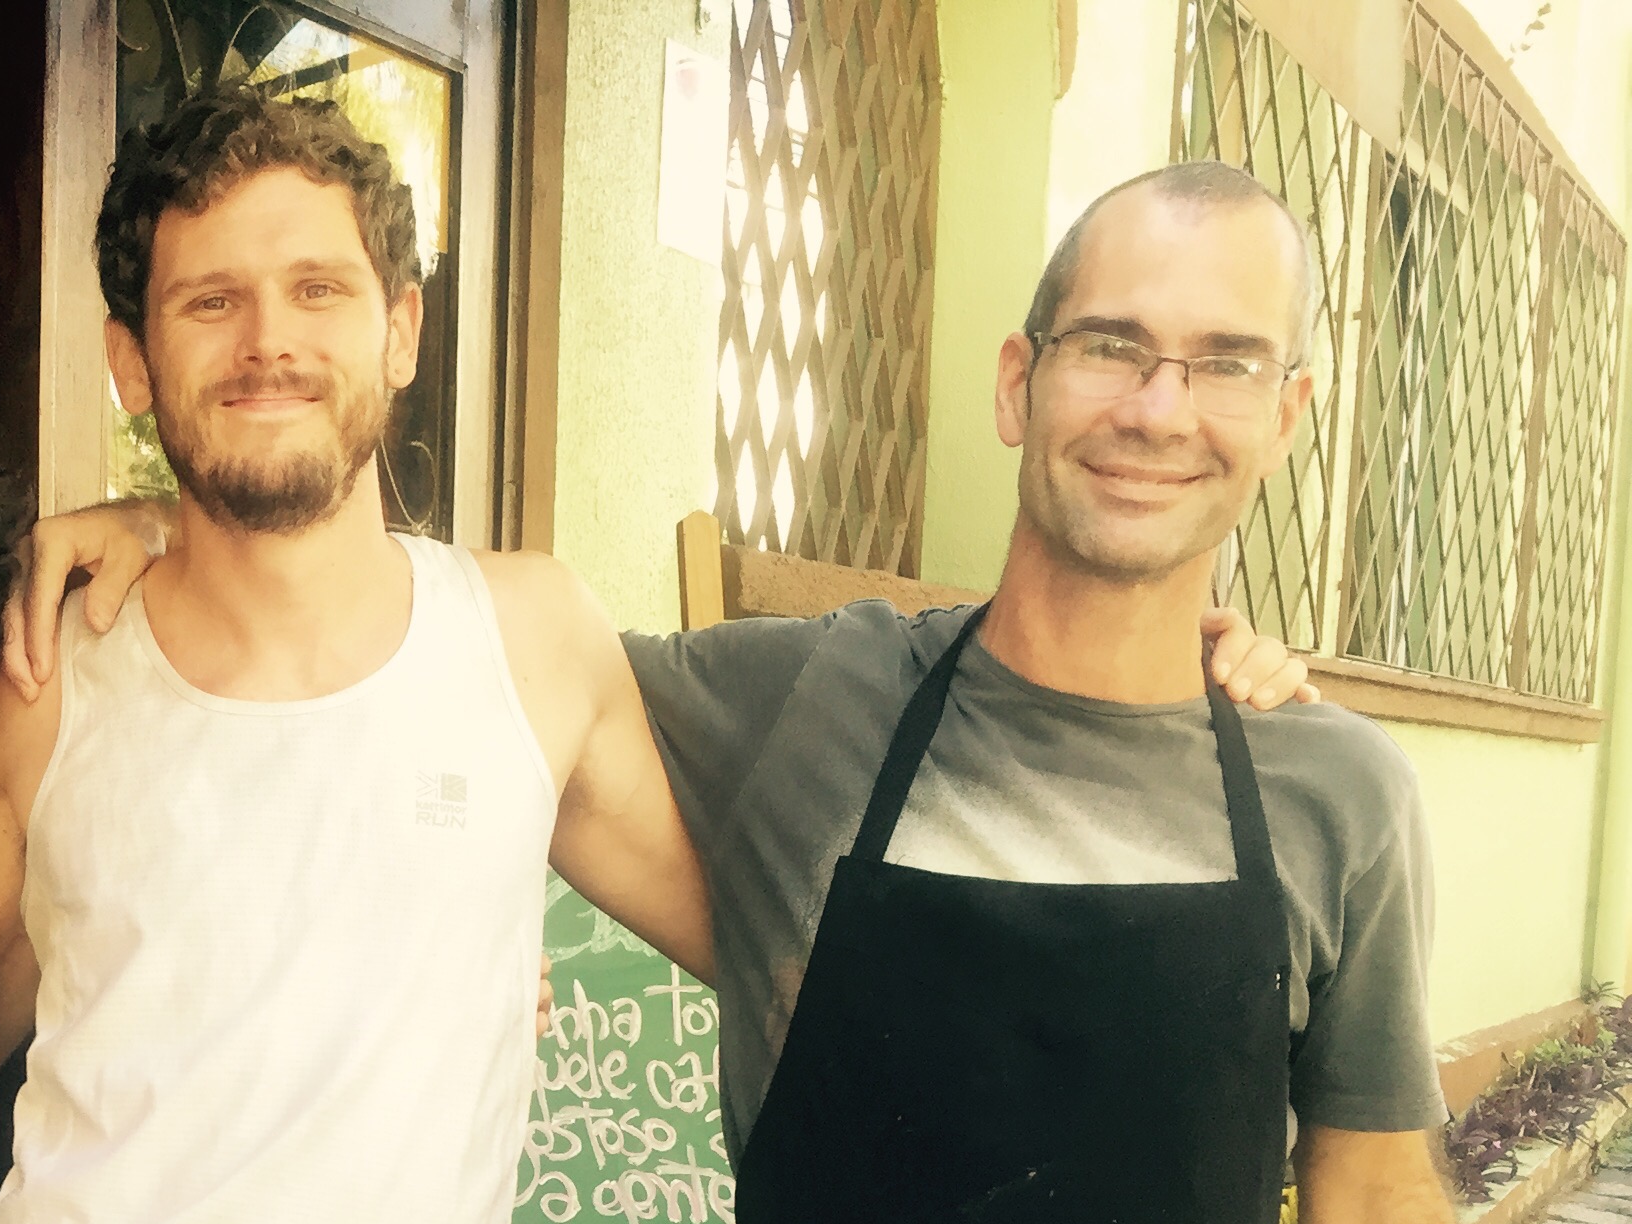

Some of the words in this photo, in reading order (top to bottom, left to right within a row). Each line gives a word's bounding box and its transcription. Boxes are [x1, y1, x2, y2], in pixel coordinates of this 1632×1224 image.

[415, 811, 467, 831] RUN
[542, 979, 642, 1050] nha
[539, 1171, 582, 1223] a
